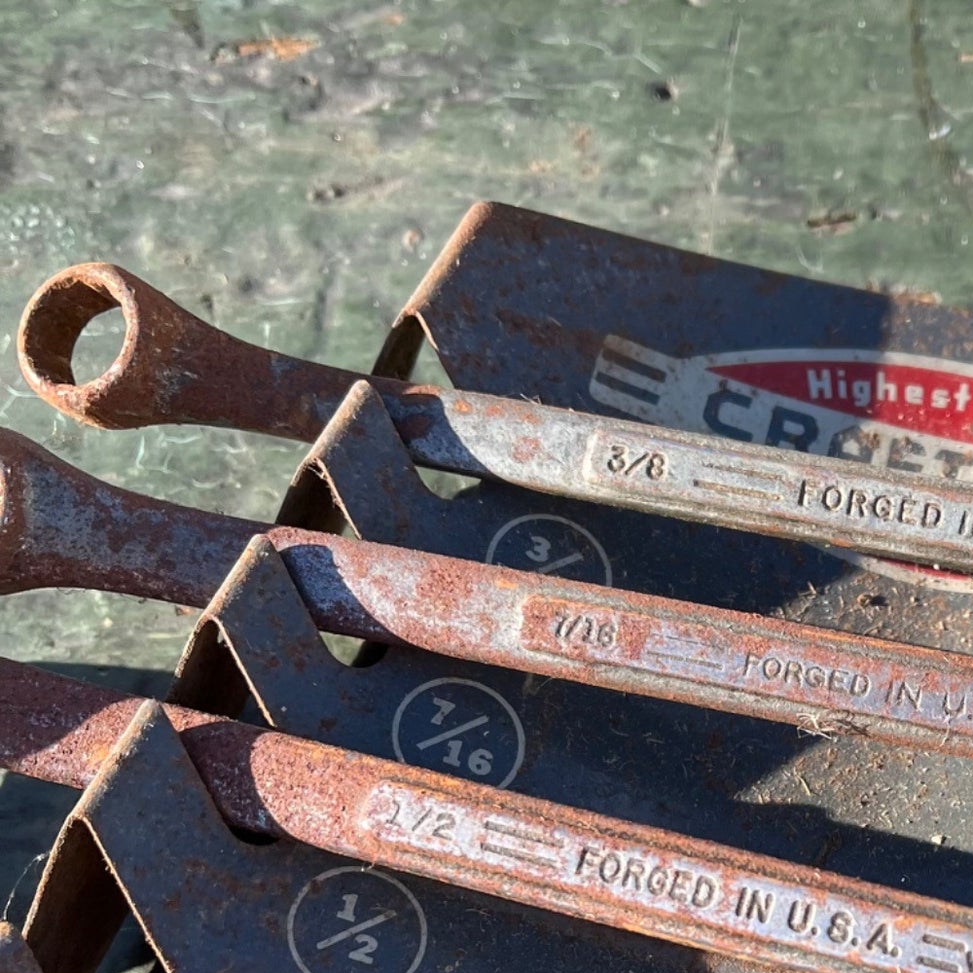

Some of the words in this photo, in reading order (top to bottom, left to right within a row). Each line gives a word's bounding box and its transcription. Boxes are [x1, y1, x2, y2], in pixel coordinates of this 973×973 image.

[807, 368, 972, 411] Highest
[606, 444, 668, 481] 3/8
[797, 478, 943, 529] FORGED
[554, 611, 619, 648] 7/16
[743, 653, 871, 698] FORGED
[885, 680, 923, 713] IN
[416, 698, 495, 776] 7/16
[384, 799, 458, 842] 1/2
[574, 846, 720, 910] FORGED
[735, 885, 774, 924] IN
[788, 900, 903, 958] U.S.A.
[316, 893, 397, 965] 1/2
